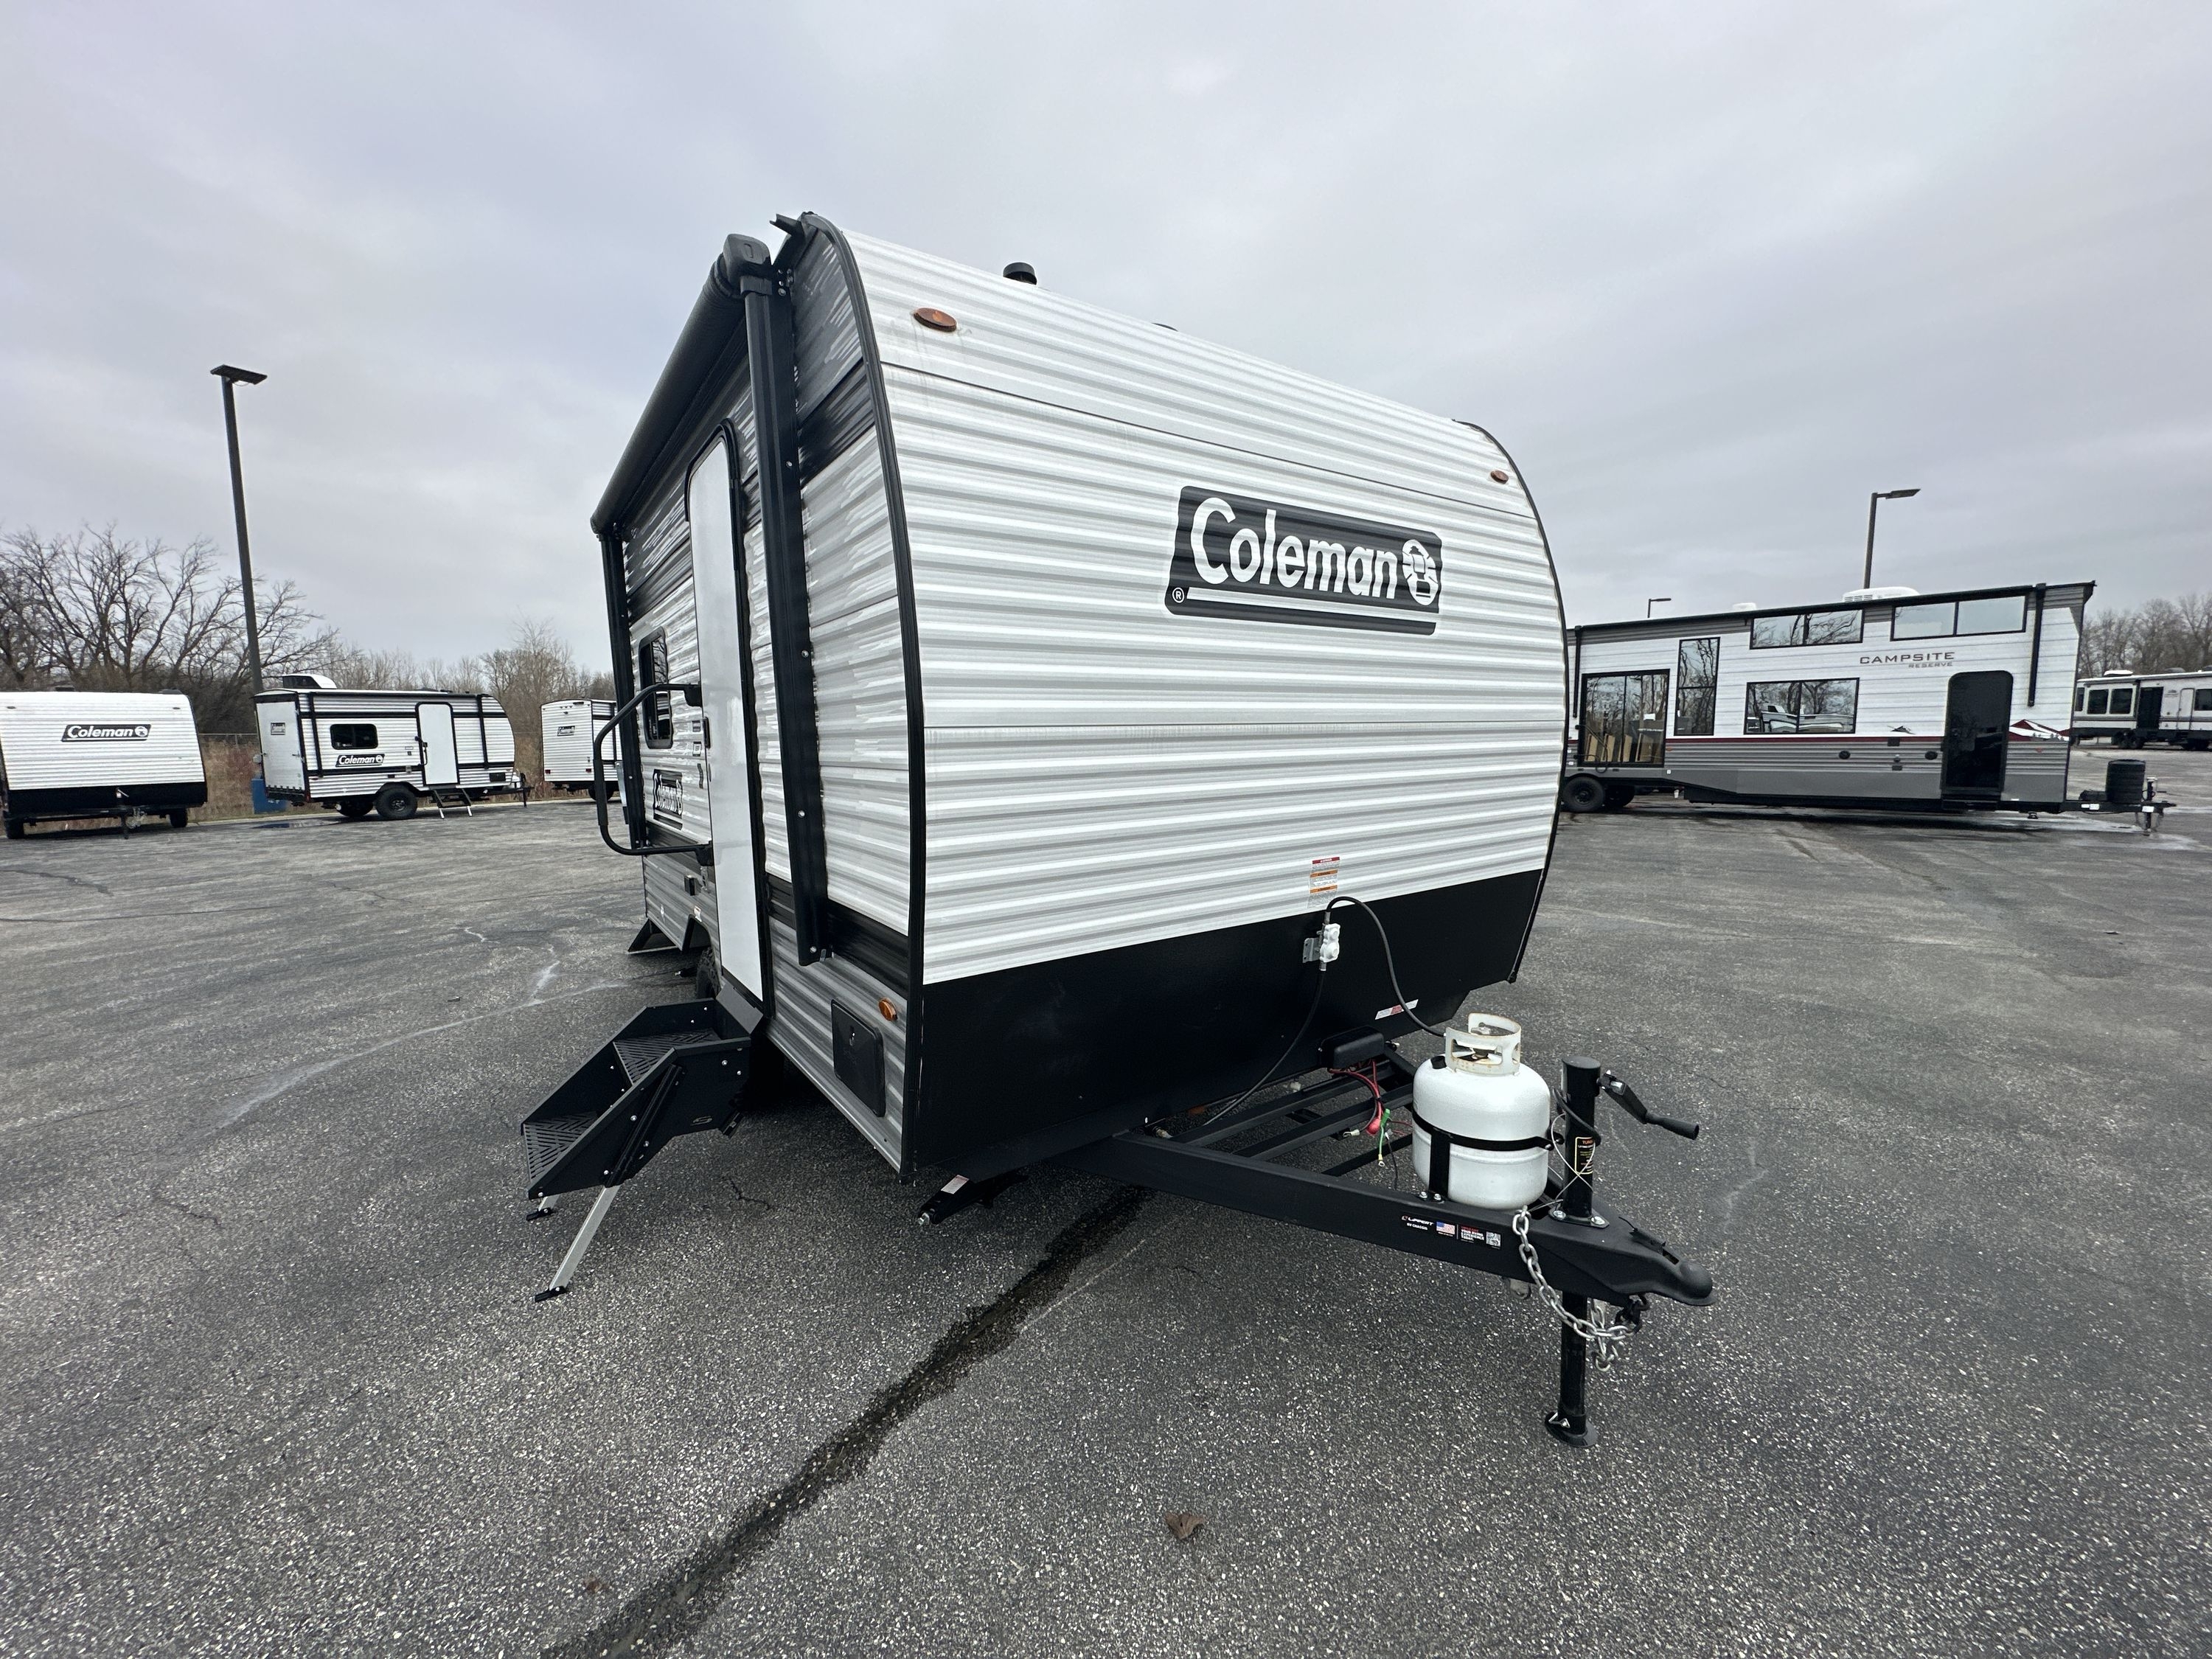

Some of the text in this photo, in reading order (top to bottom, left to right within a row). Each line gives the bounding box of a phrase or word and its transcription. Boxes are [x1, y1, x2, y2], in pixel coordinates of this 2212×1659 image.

[1190, 497, 1398, 599] Coleman
[1860, 652, 1955, 664] CAMPSITE
[67, 726, 133, 738] Coleman
[339, 755, 375, 765] Coleman
